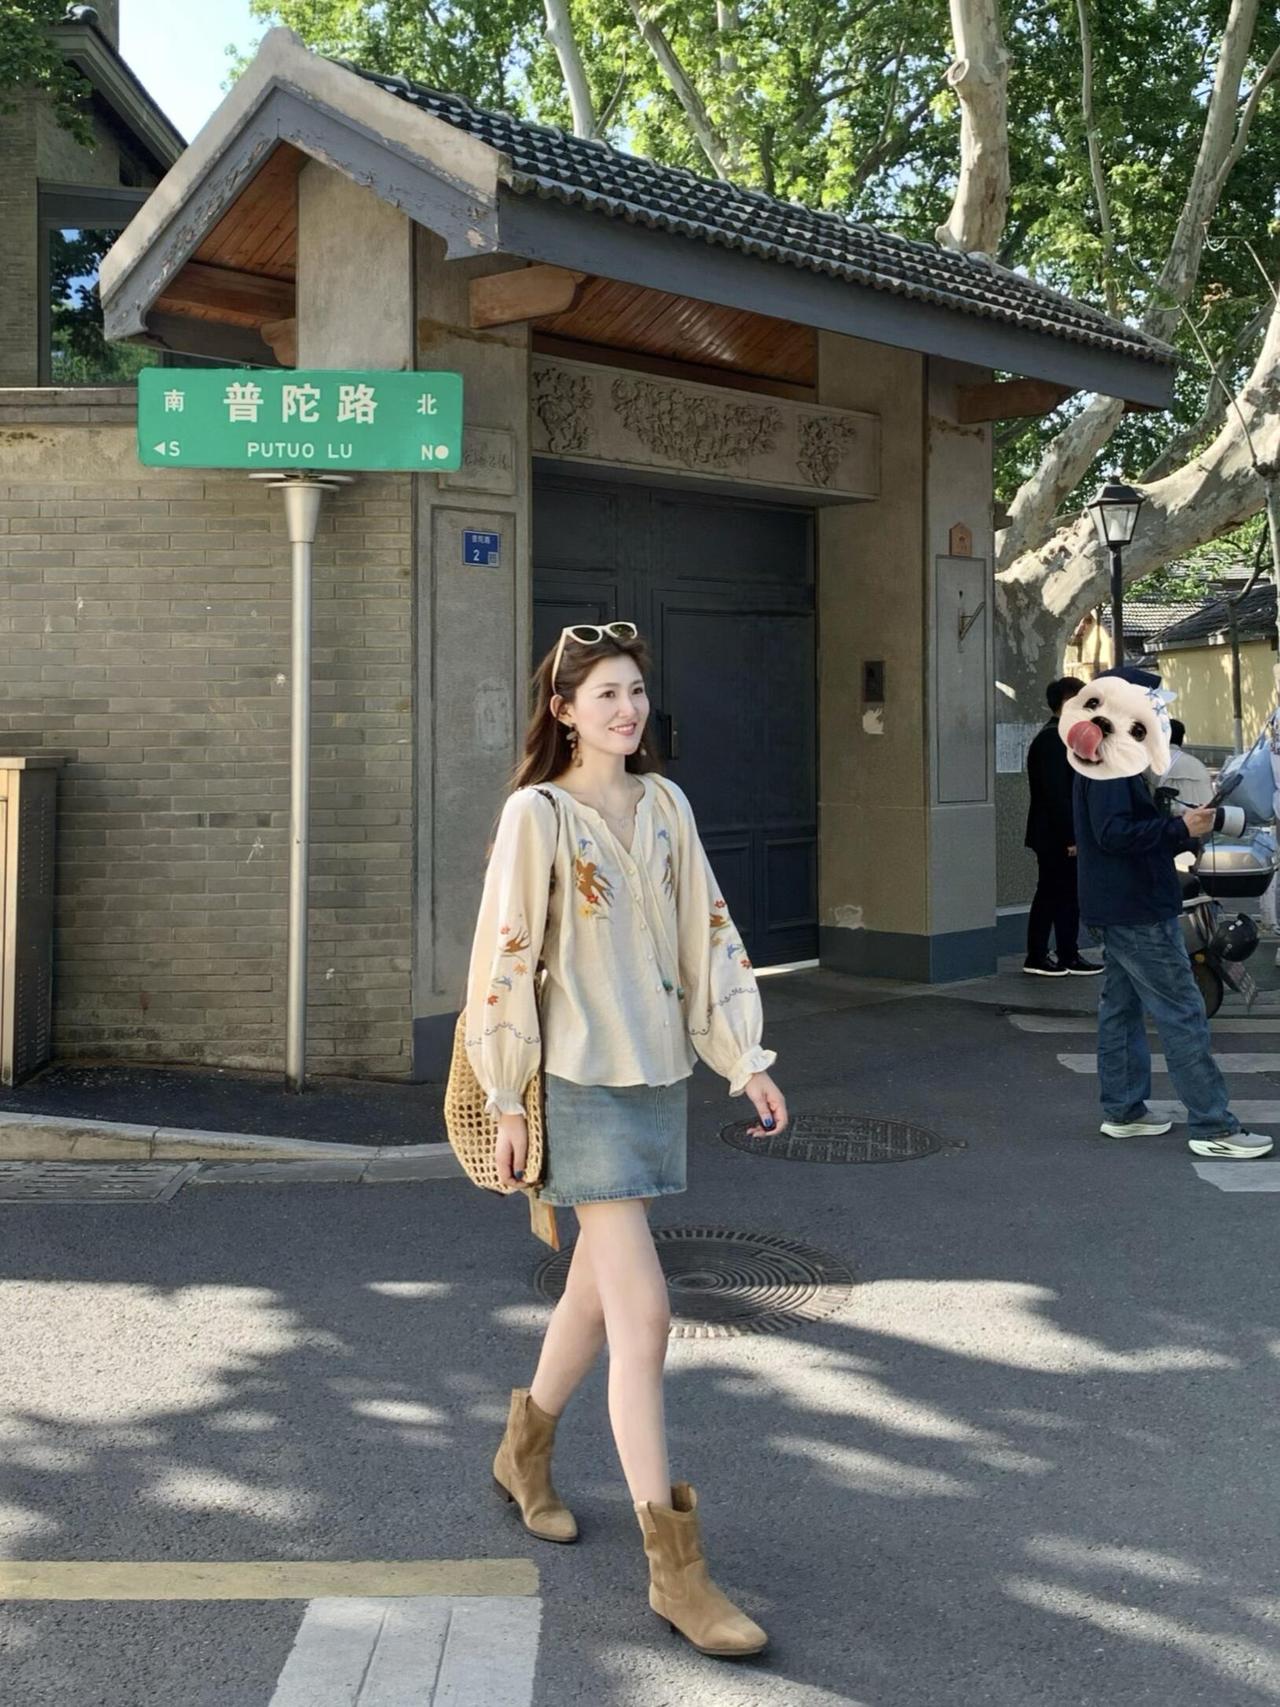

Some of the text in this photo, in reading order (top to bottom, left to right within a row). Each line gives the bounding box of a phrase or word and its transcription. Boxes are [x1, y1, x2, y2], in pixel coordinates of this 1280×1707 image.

[164, 389, 185, 412] 南
[223, 382, 378, 424] 普陀路
[417, 393, 437, 415] 北
[169, 441, 180, 457] S
[247, 442, 352, 459] PUTUO LU
[473, 549, 480, 561] 2
